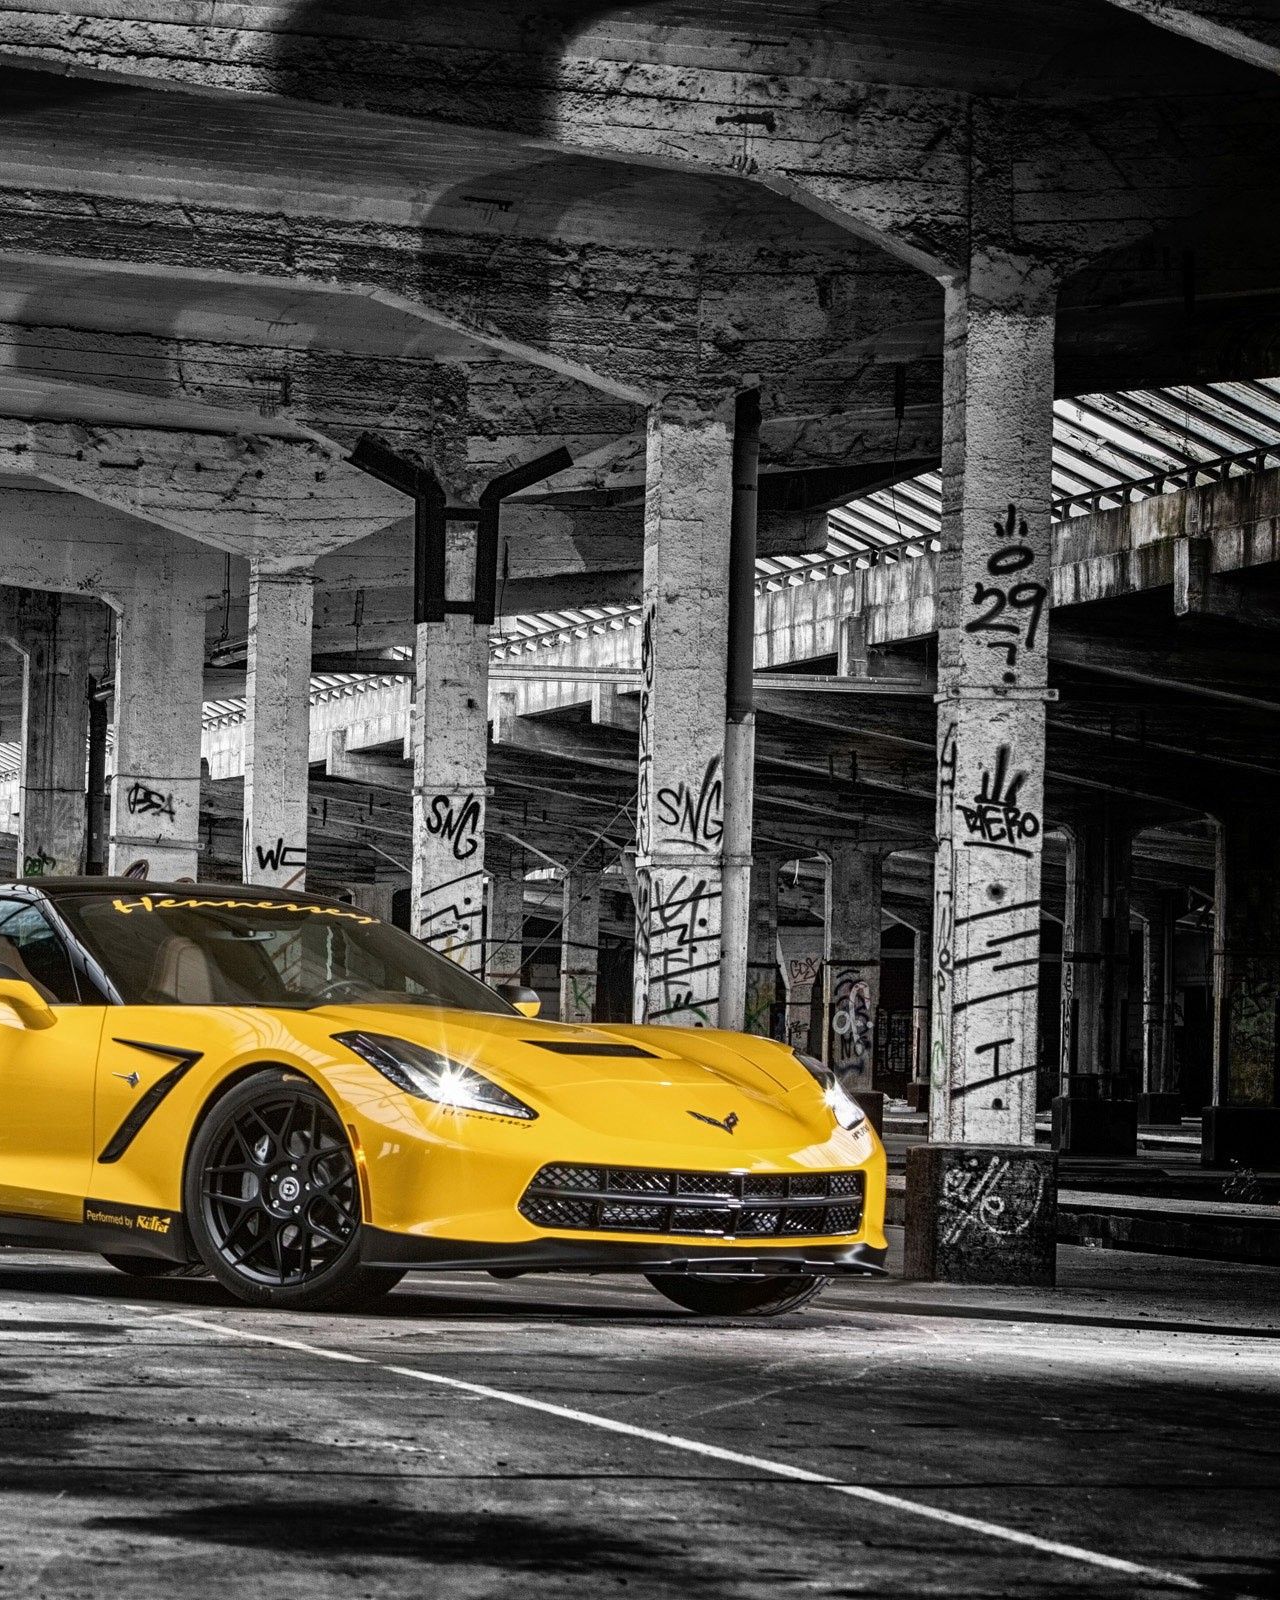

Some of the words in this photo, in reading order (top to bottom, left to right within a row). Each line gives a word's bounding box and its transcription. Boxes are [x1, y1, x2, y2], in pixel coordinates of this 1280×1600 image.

[426, 793, 481, 861] SNG
[257, 838, 306, 871] WC
[86, 1209, 124, 1226] Performed
[124, 1215, 134, 1229] by
